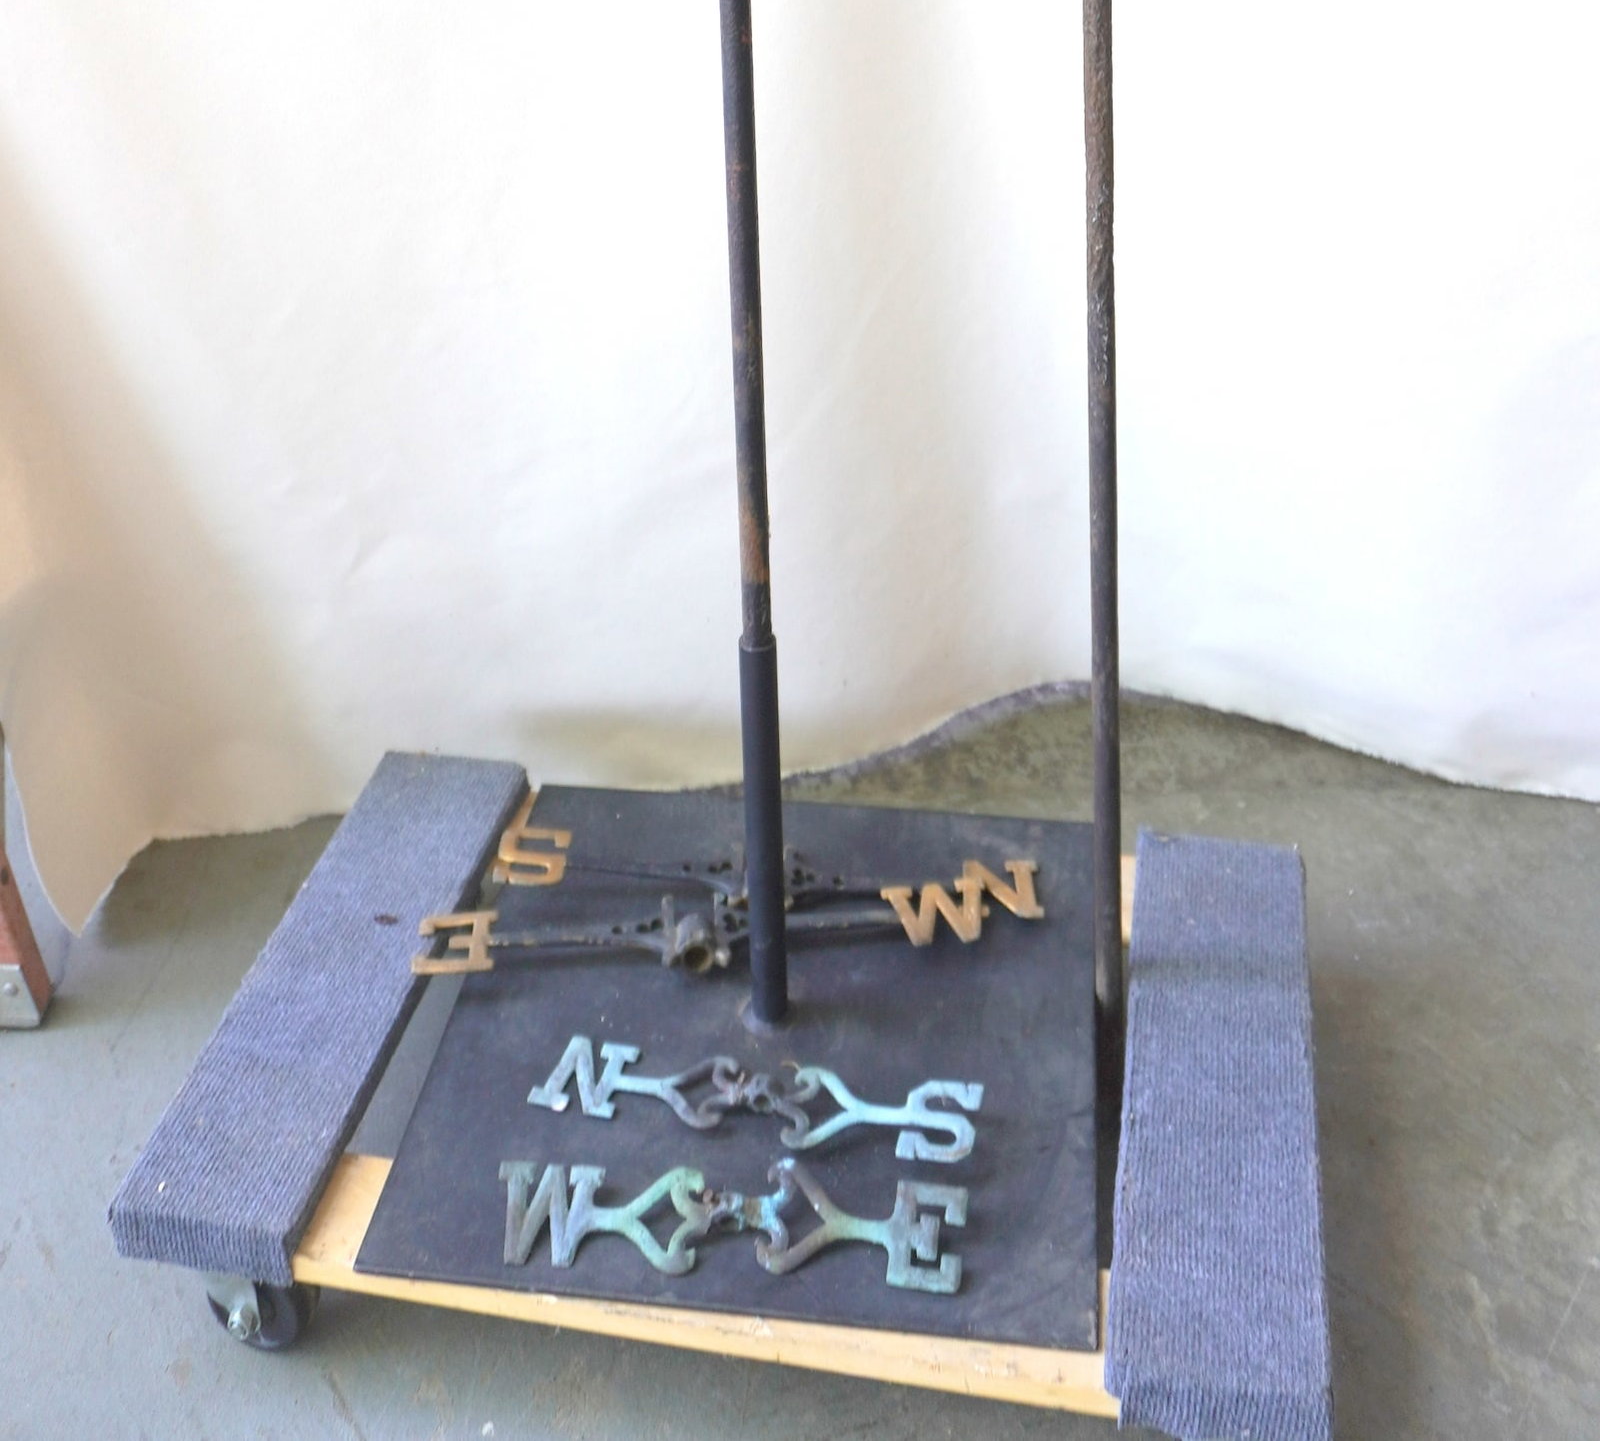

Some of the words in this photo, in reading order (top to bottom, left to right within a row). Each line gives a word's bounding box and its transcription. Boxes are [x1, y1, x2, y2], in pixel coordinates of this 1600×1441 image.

[493, 825, 573, 886] S
[962, 859, 1045, 919] N
[880, 882, 985, 946] W
[527, 1034, 641, 1119] N
[895, 1080, 984, 1164] S
[498, 1160, 606, 1268] W
[886, 1179, 968, 1293] E
